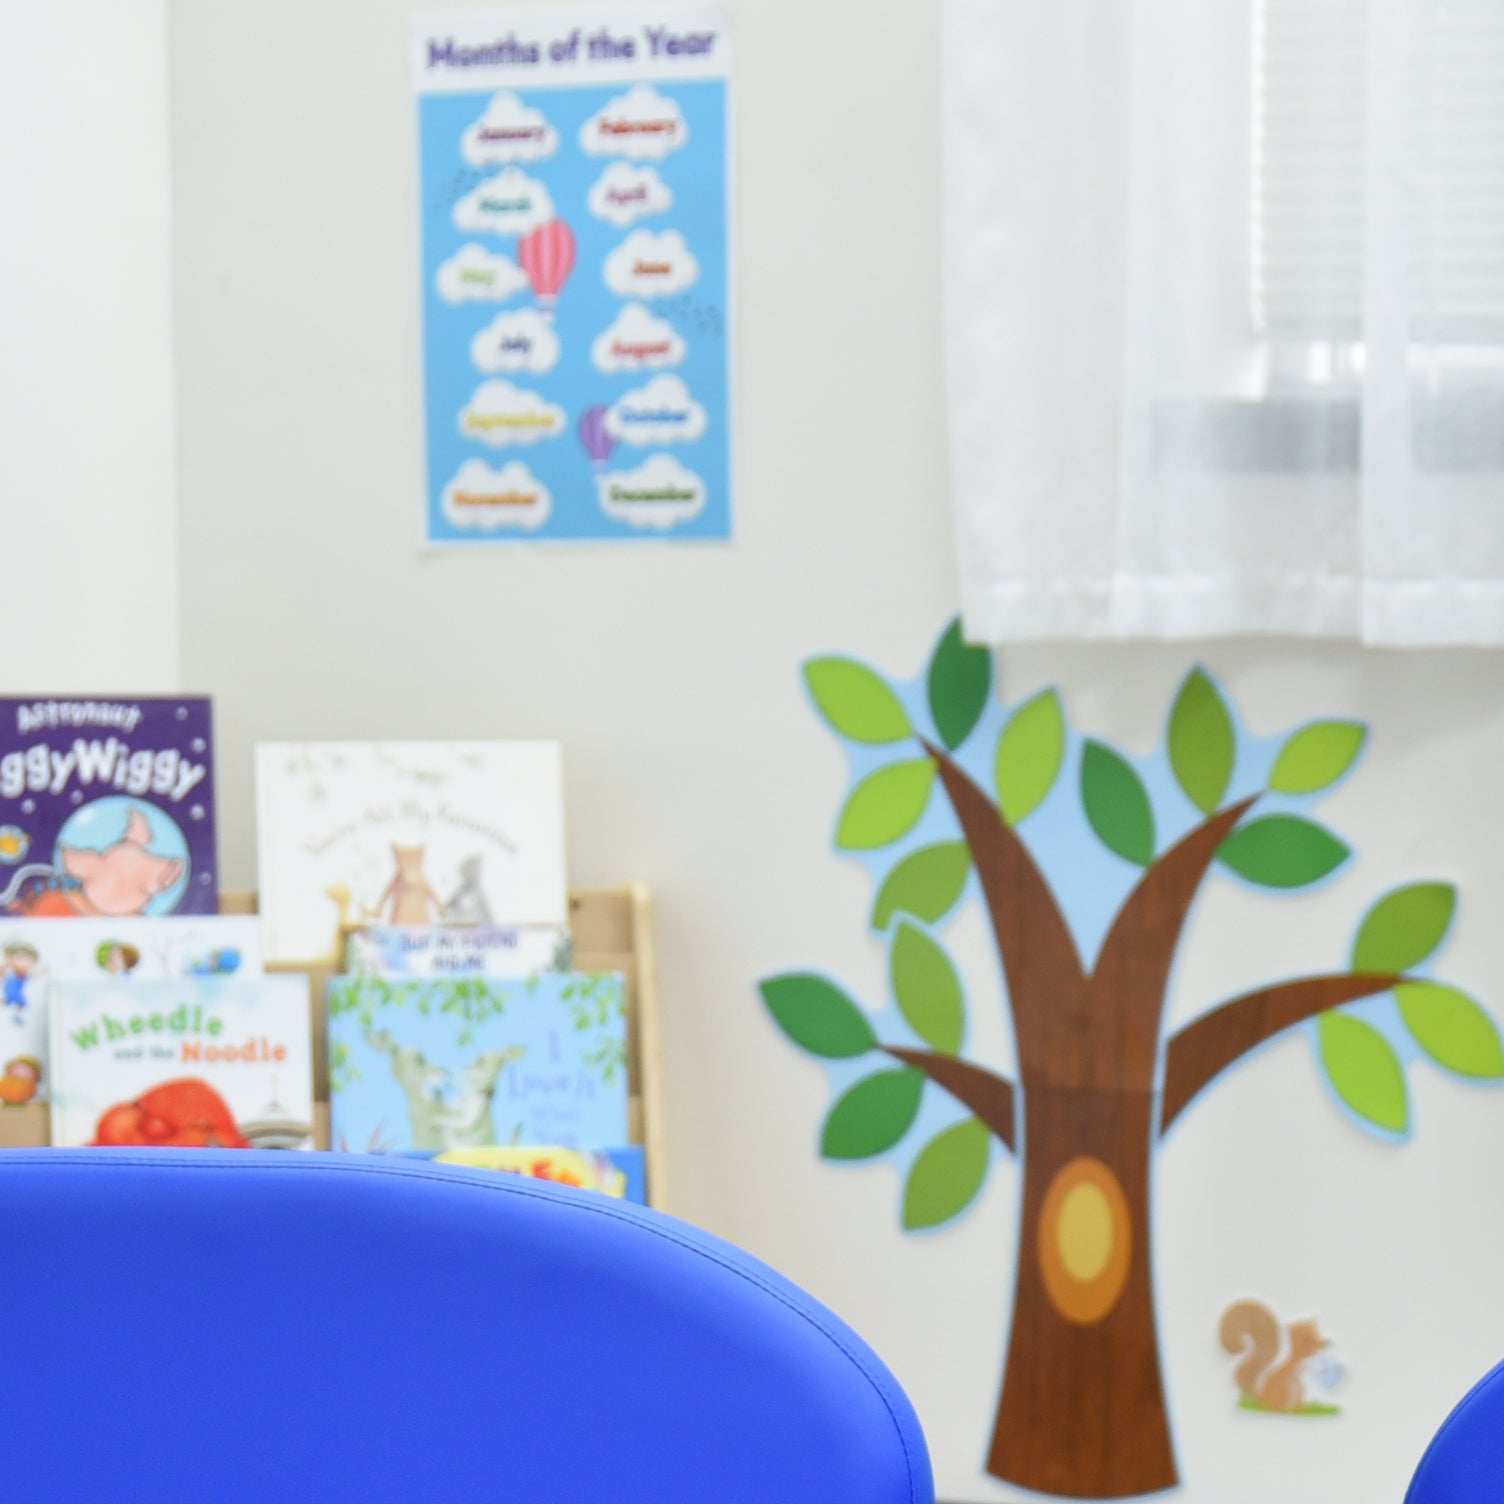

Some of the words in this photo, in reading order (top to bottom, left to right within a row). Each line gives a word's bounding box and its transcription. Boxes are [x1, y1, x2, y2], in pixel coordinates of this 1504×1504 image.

[427, 31, 539, 67] Months
[549, 28, 580, 61] of
[588, 27, 635, 59] the
[645, 25, 715, 56] Year
[500, 336, 532, 354] July
[17, 700, 143, 735] Astronaut
[70, 1003, 223, 1050] Wheedle
[113, 1045, 142, 1059] and
[150, 1045, 174, 1059] the
[181, 1037, 287, 1063] Noodle
